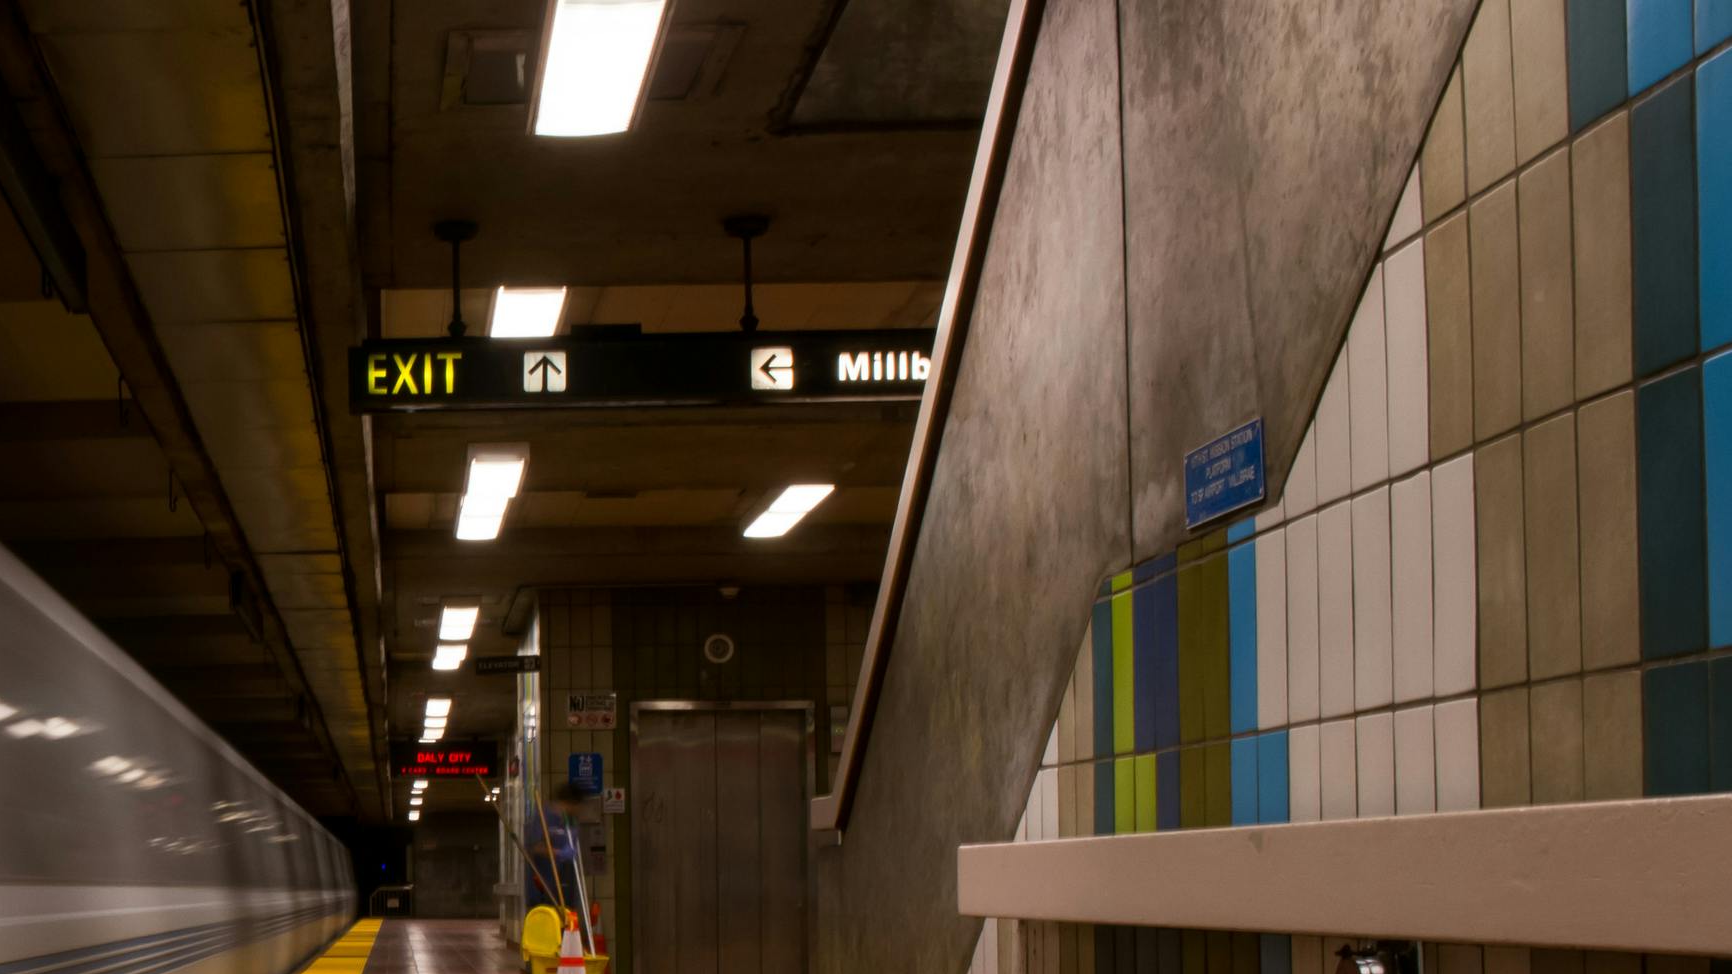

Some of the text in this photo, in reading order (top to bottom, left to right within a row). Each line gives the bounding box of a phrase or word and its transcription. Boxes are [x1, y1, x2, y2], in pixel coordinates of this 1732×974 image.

[368, 352, 463, 395] EXIT
[478, 660, 520, 669] ELEVATOR
[569, 695, 585, 712] NO
[417, 752, 471, 763] DALY CITY
